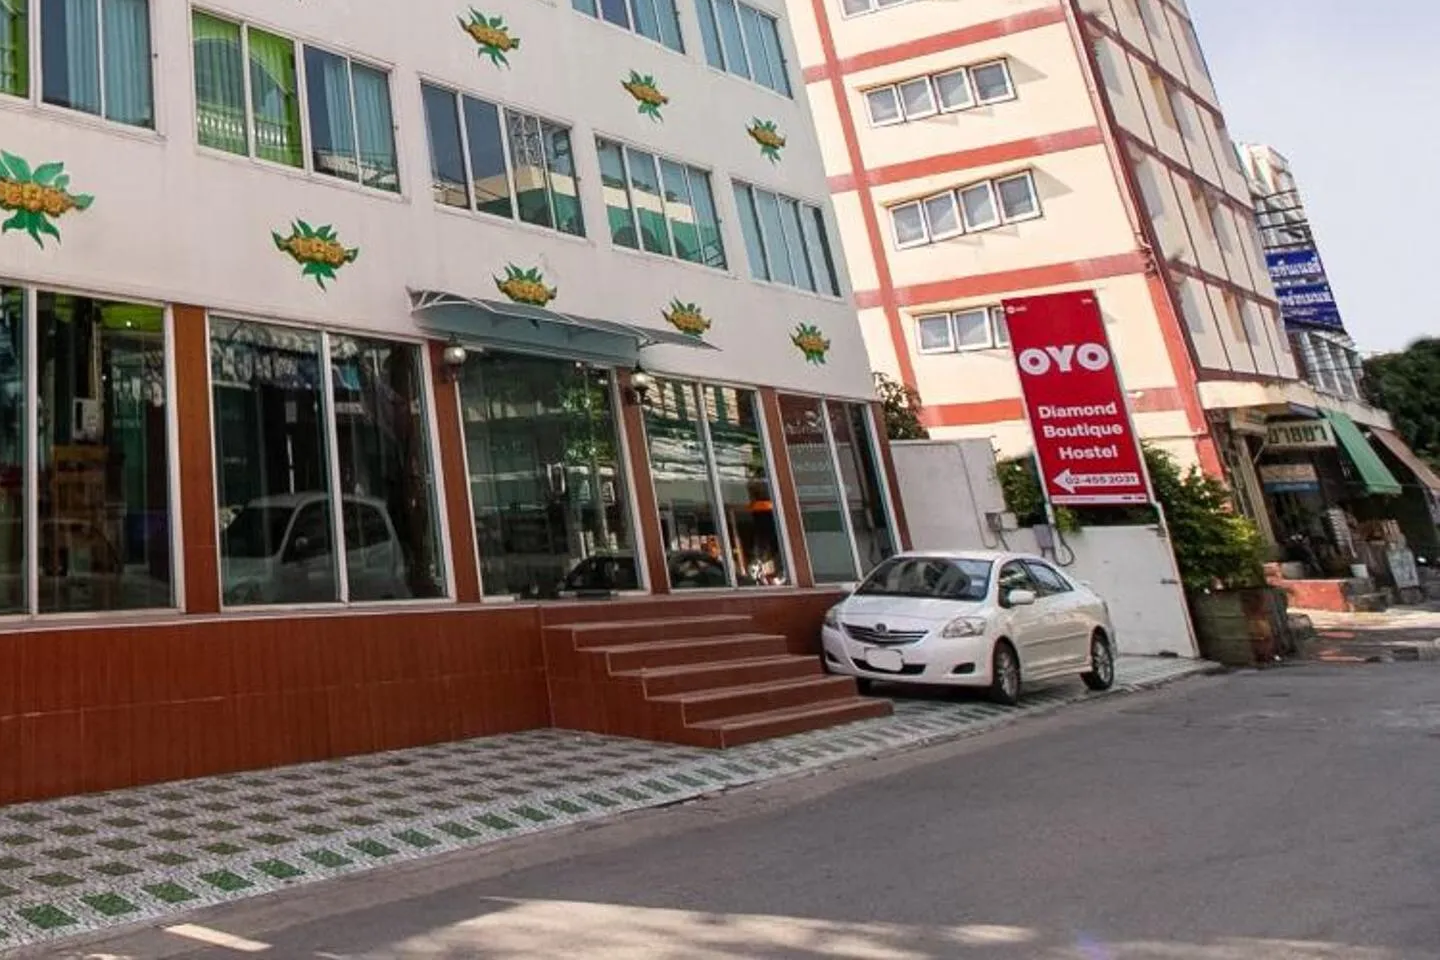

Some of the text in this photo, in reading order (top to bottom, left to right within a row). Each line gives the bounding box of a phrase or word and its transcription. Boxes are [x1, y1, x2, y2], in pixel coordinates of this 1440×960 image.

[1019, 343, 1110, 375] OYO
[1038, 402, 1117, 419] Diamond
[1042, 423, 1123, 438] Boutique
[1058, 445, 1119, 460] Hostel
